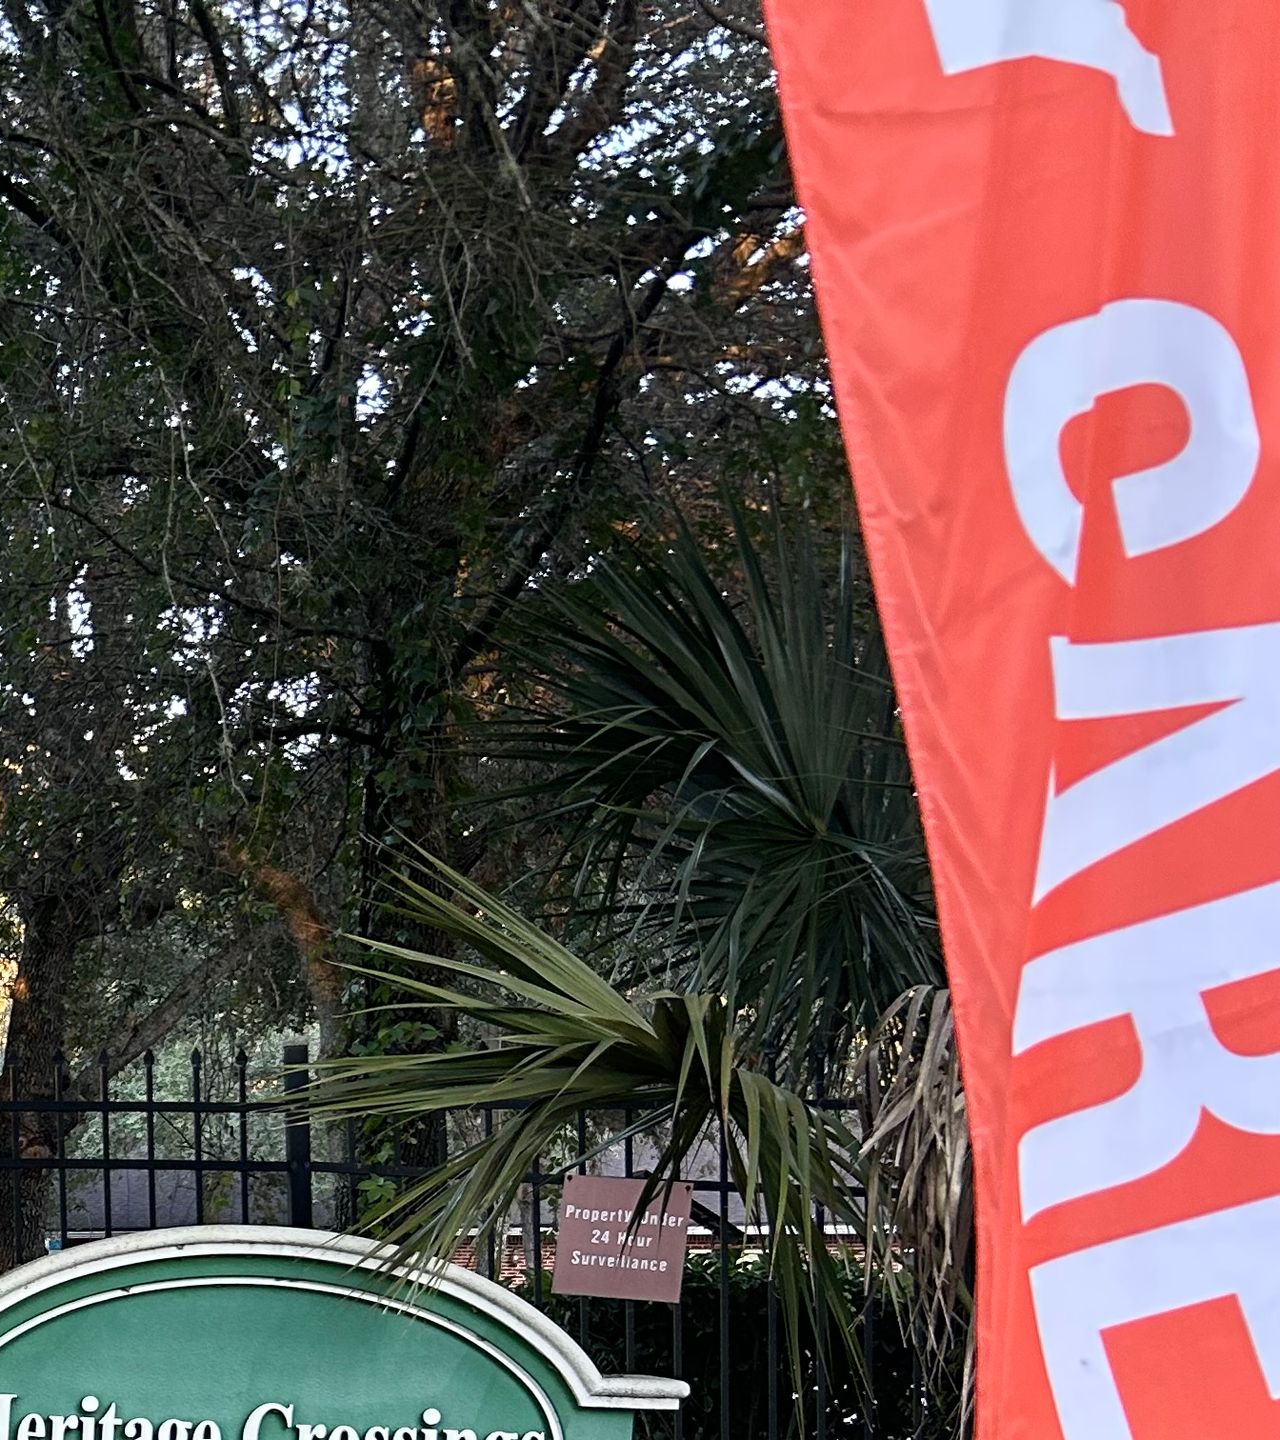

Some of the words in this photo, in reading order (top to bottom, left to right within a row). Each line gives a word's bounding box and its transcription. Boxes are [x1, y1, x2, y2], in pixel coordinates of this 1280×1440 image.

[565, 1204, 632, 1224] Property
[591, 1229, 610, 1244] 24
[571, 1250, 668, 1272] Surveillance
